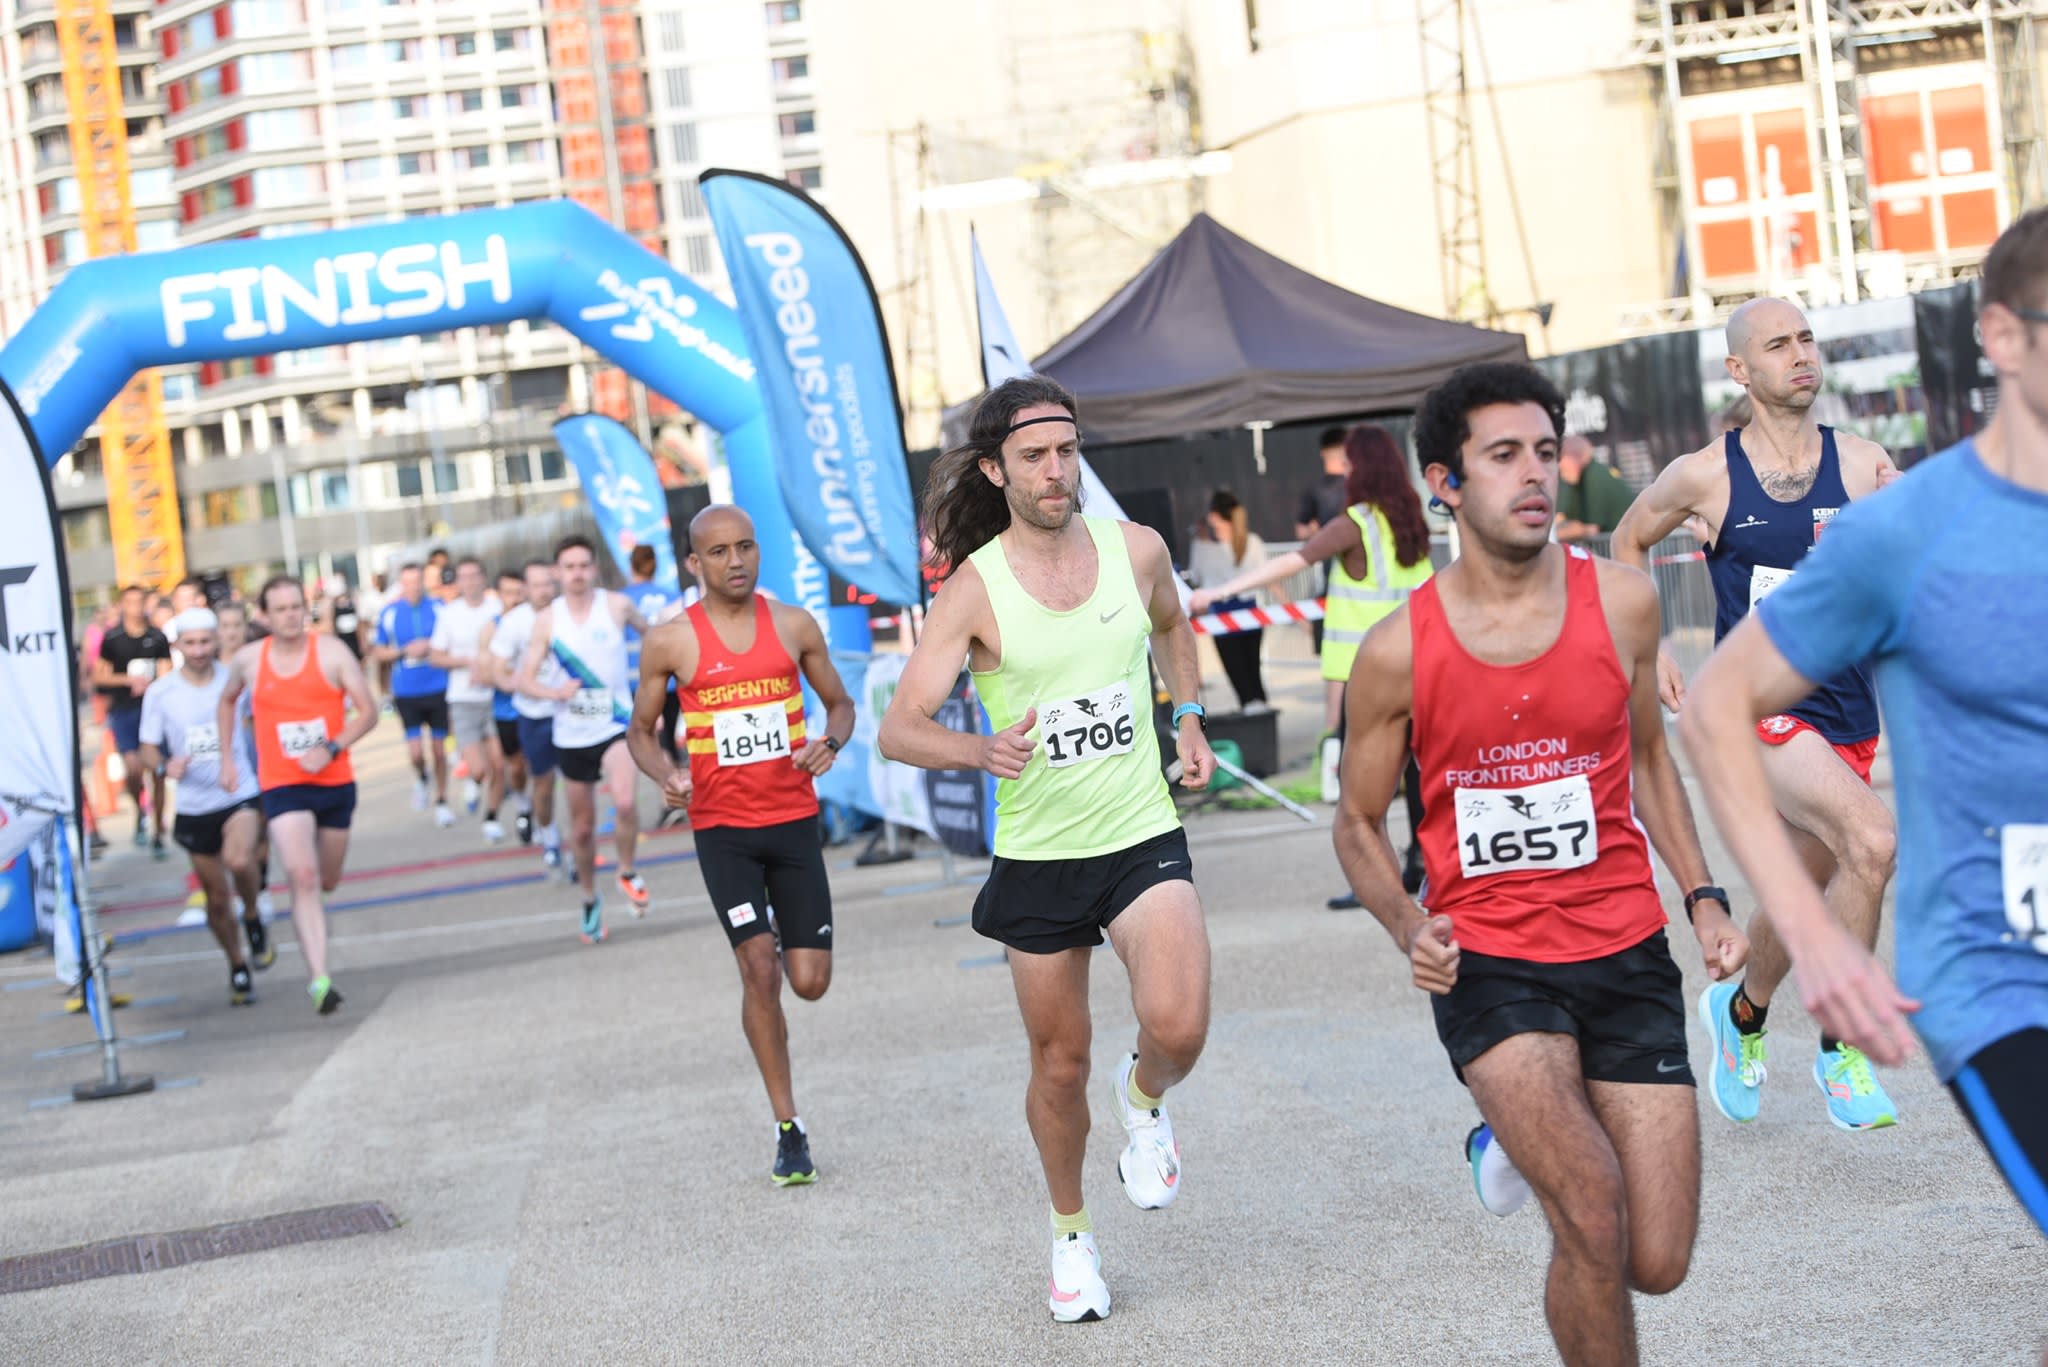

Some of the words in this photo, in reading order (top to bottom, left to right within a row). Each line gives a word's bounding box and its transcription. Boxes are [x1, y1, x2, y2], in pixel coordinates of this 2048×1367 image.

[160, 234, 511, 348] FINISH
[744, 231, 873, 565] runnersneed
[1812, 508, 1840, 517] KENT
[15, 631, 57, 654] KIT
[697, 676, 792, 706] SERPENTINE
[721, 730, 785, 759] 1841
[1046, 714, 1134, 761] 1706
[1478, 738, 1568, 764] LONDON
[1446, 752, 1601, 787] FRONTRUNNERS
[1465, 820, 1589, 867] 1657
